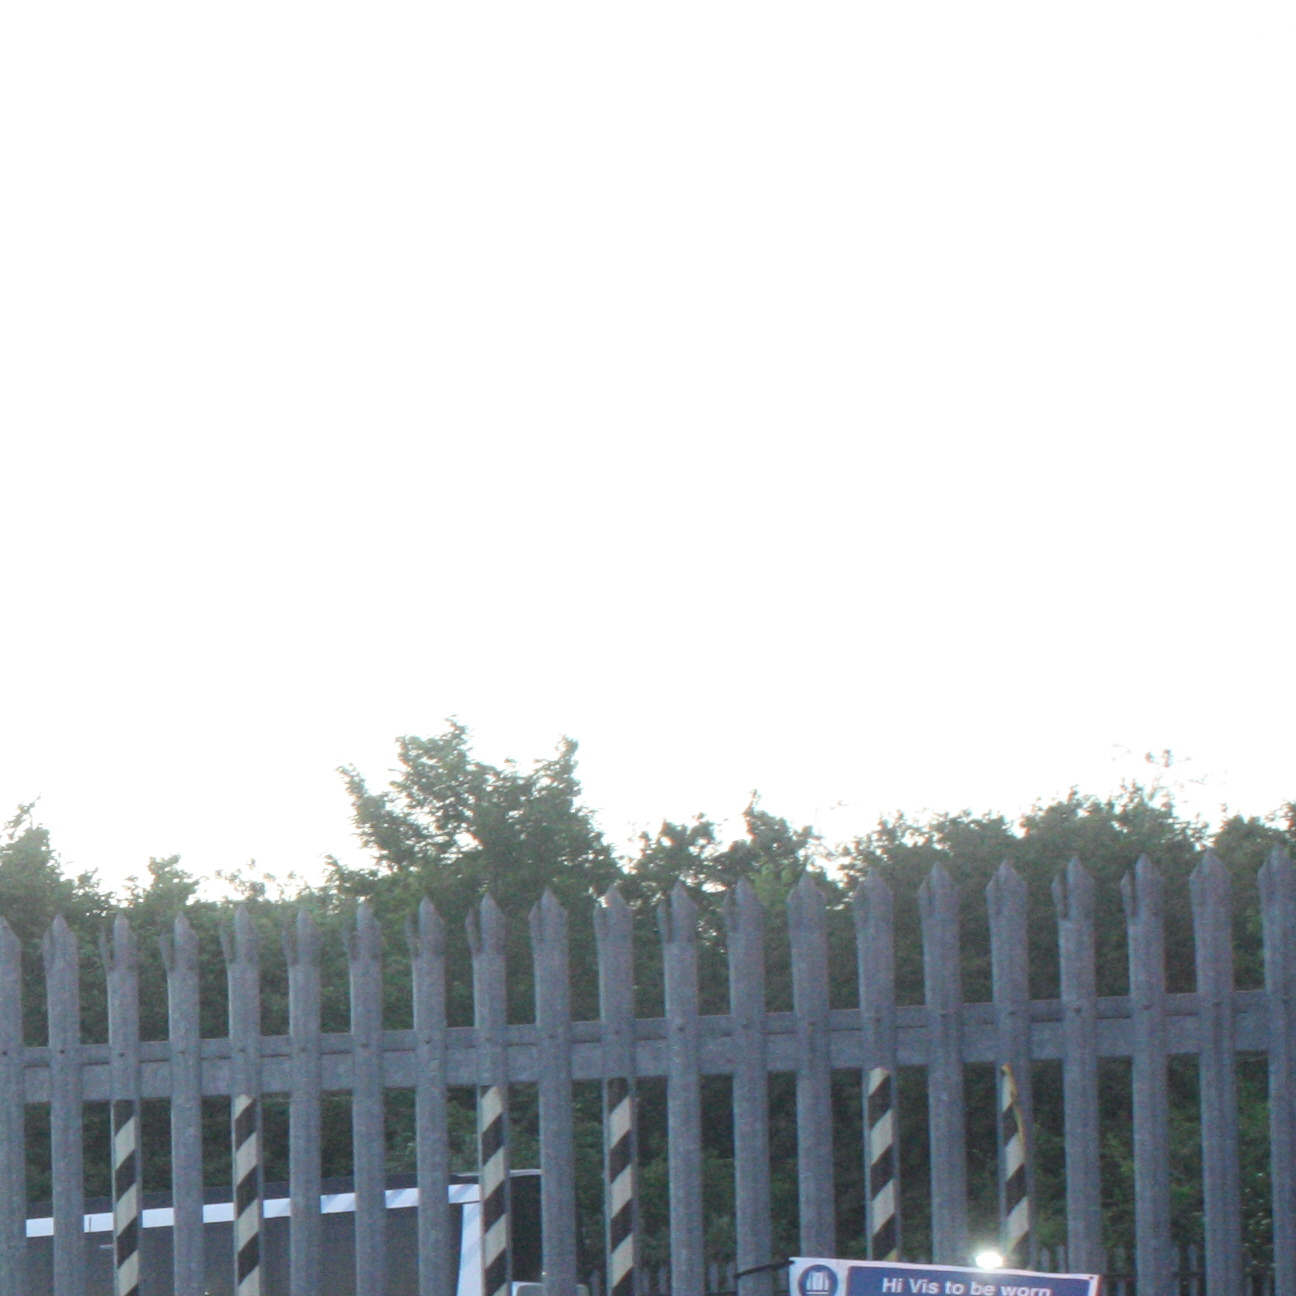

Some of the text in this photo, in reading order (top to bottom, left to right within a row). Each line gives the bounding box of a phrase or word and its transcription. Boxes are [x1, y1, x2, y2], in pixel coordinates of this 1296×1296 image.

[881, 1278, 902, 1294] Hi
[909, 1279, 939, 1295] Vis
[945, 1281, 964, 1296] to
[971, 1281, 995, 1296] be
